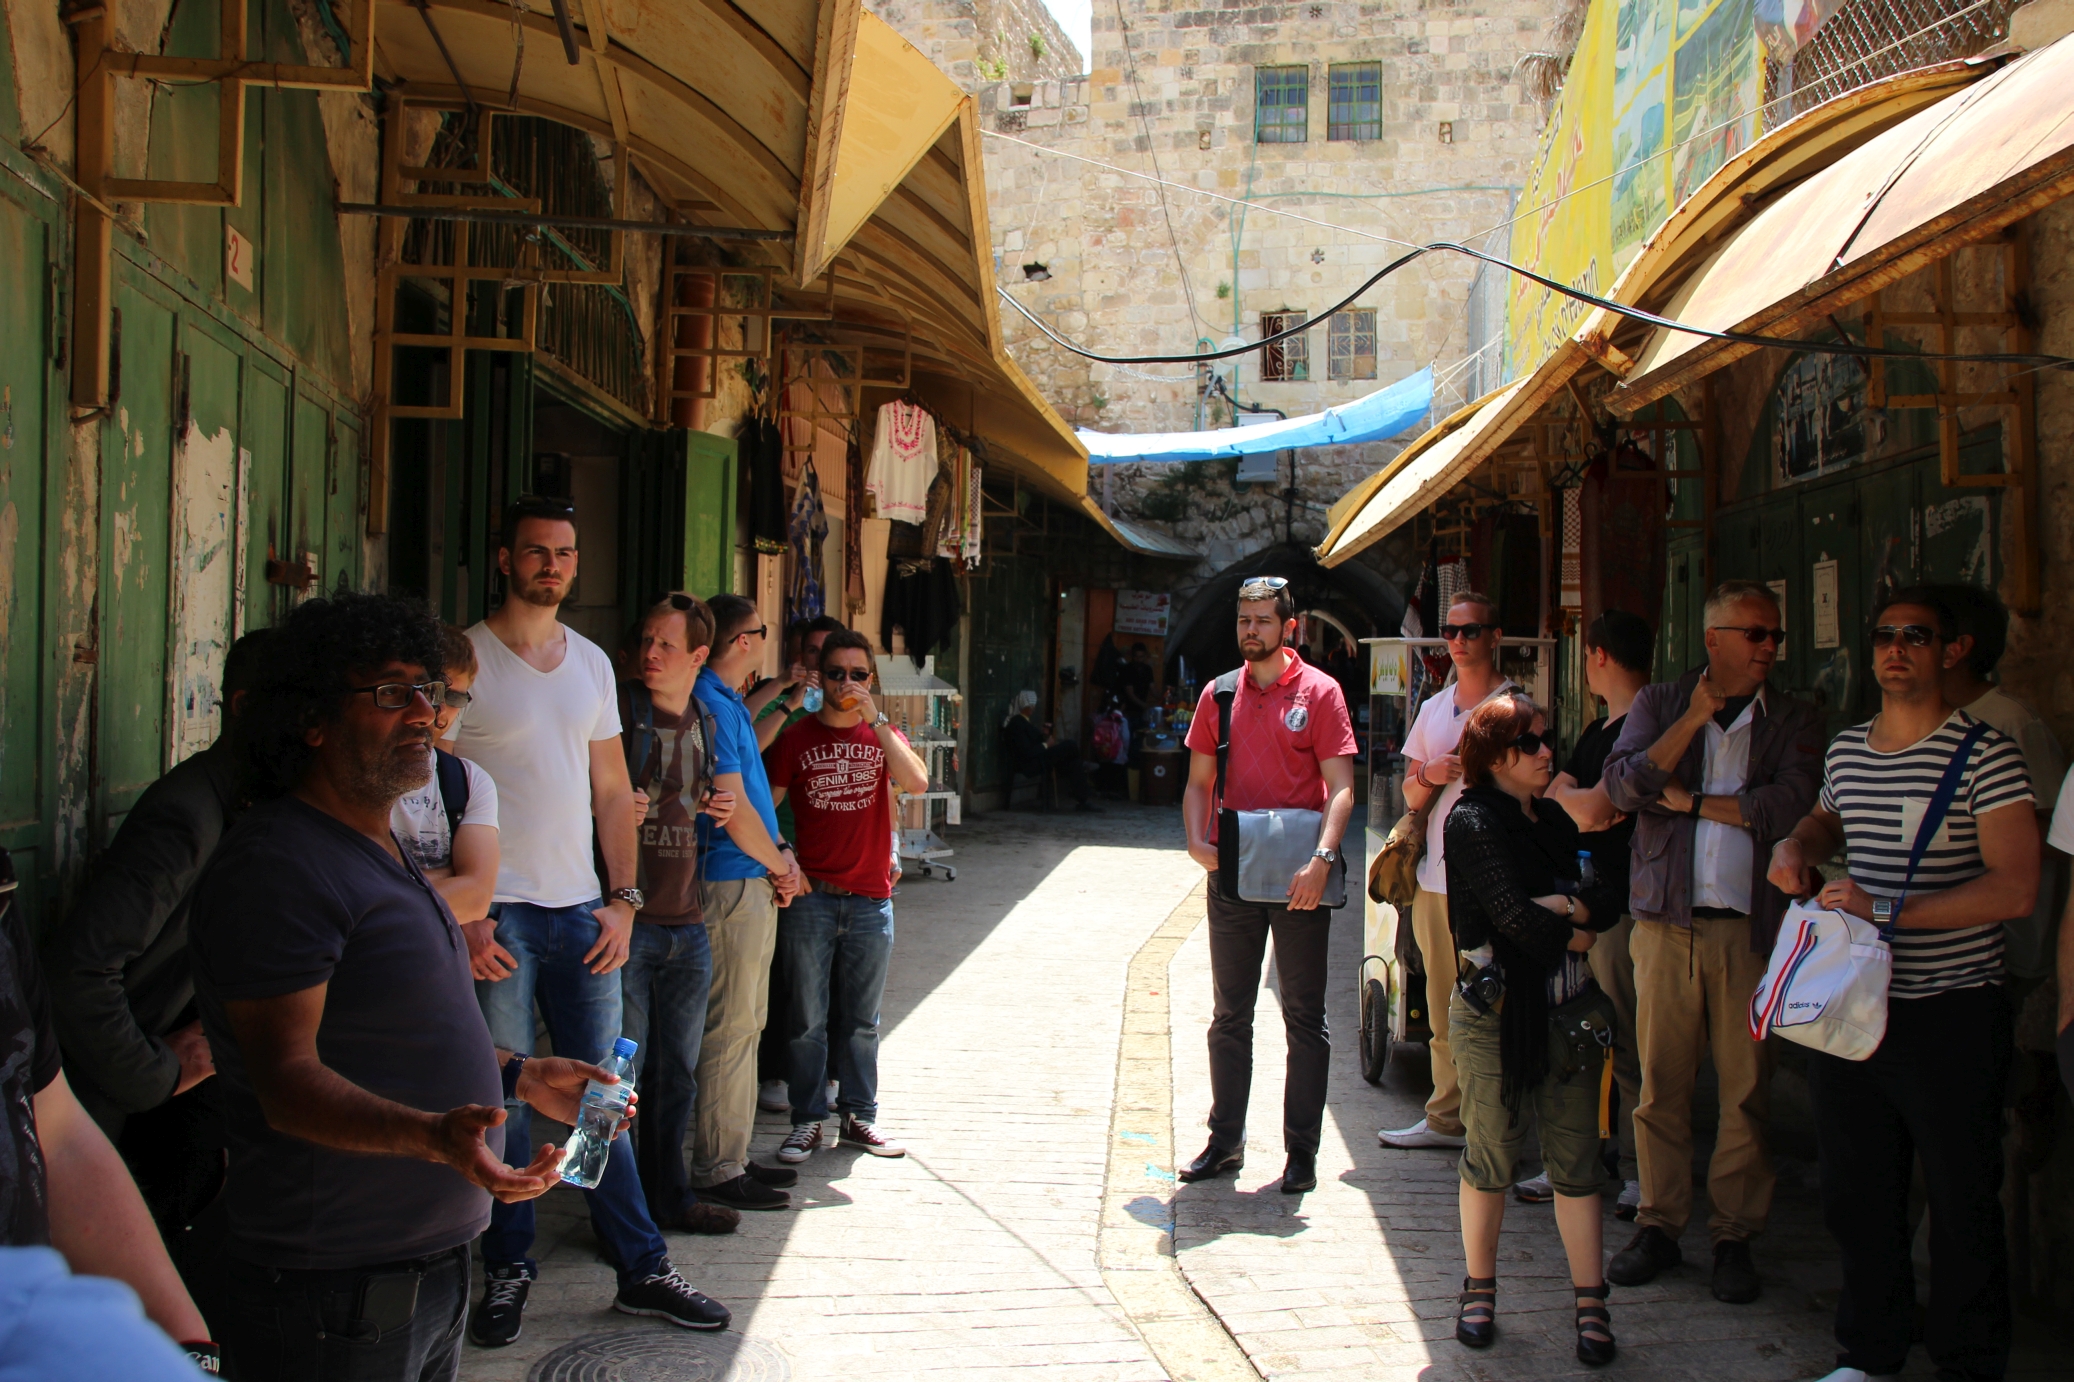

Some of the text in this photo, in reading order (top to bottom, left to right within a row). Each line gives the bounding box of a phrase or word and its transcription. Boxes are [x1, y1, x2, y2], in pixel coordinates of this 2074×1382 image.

[231, 234, 239, 275] 2
[800, 743, 885, 771] HILFIGER
[810, 769, 877, 790] DENIM 1985
[830, 801, 856, 811] YORK
